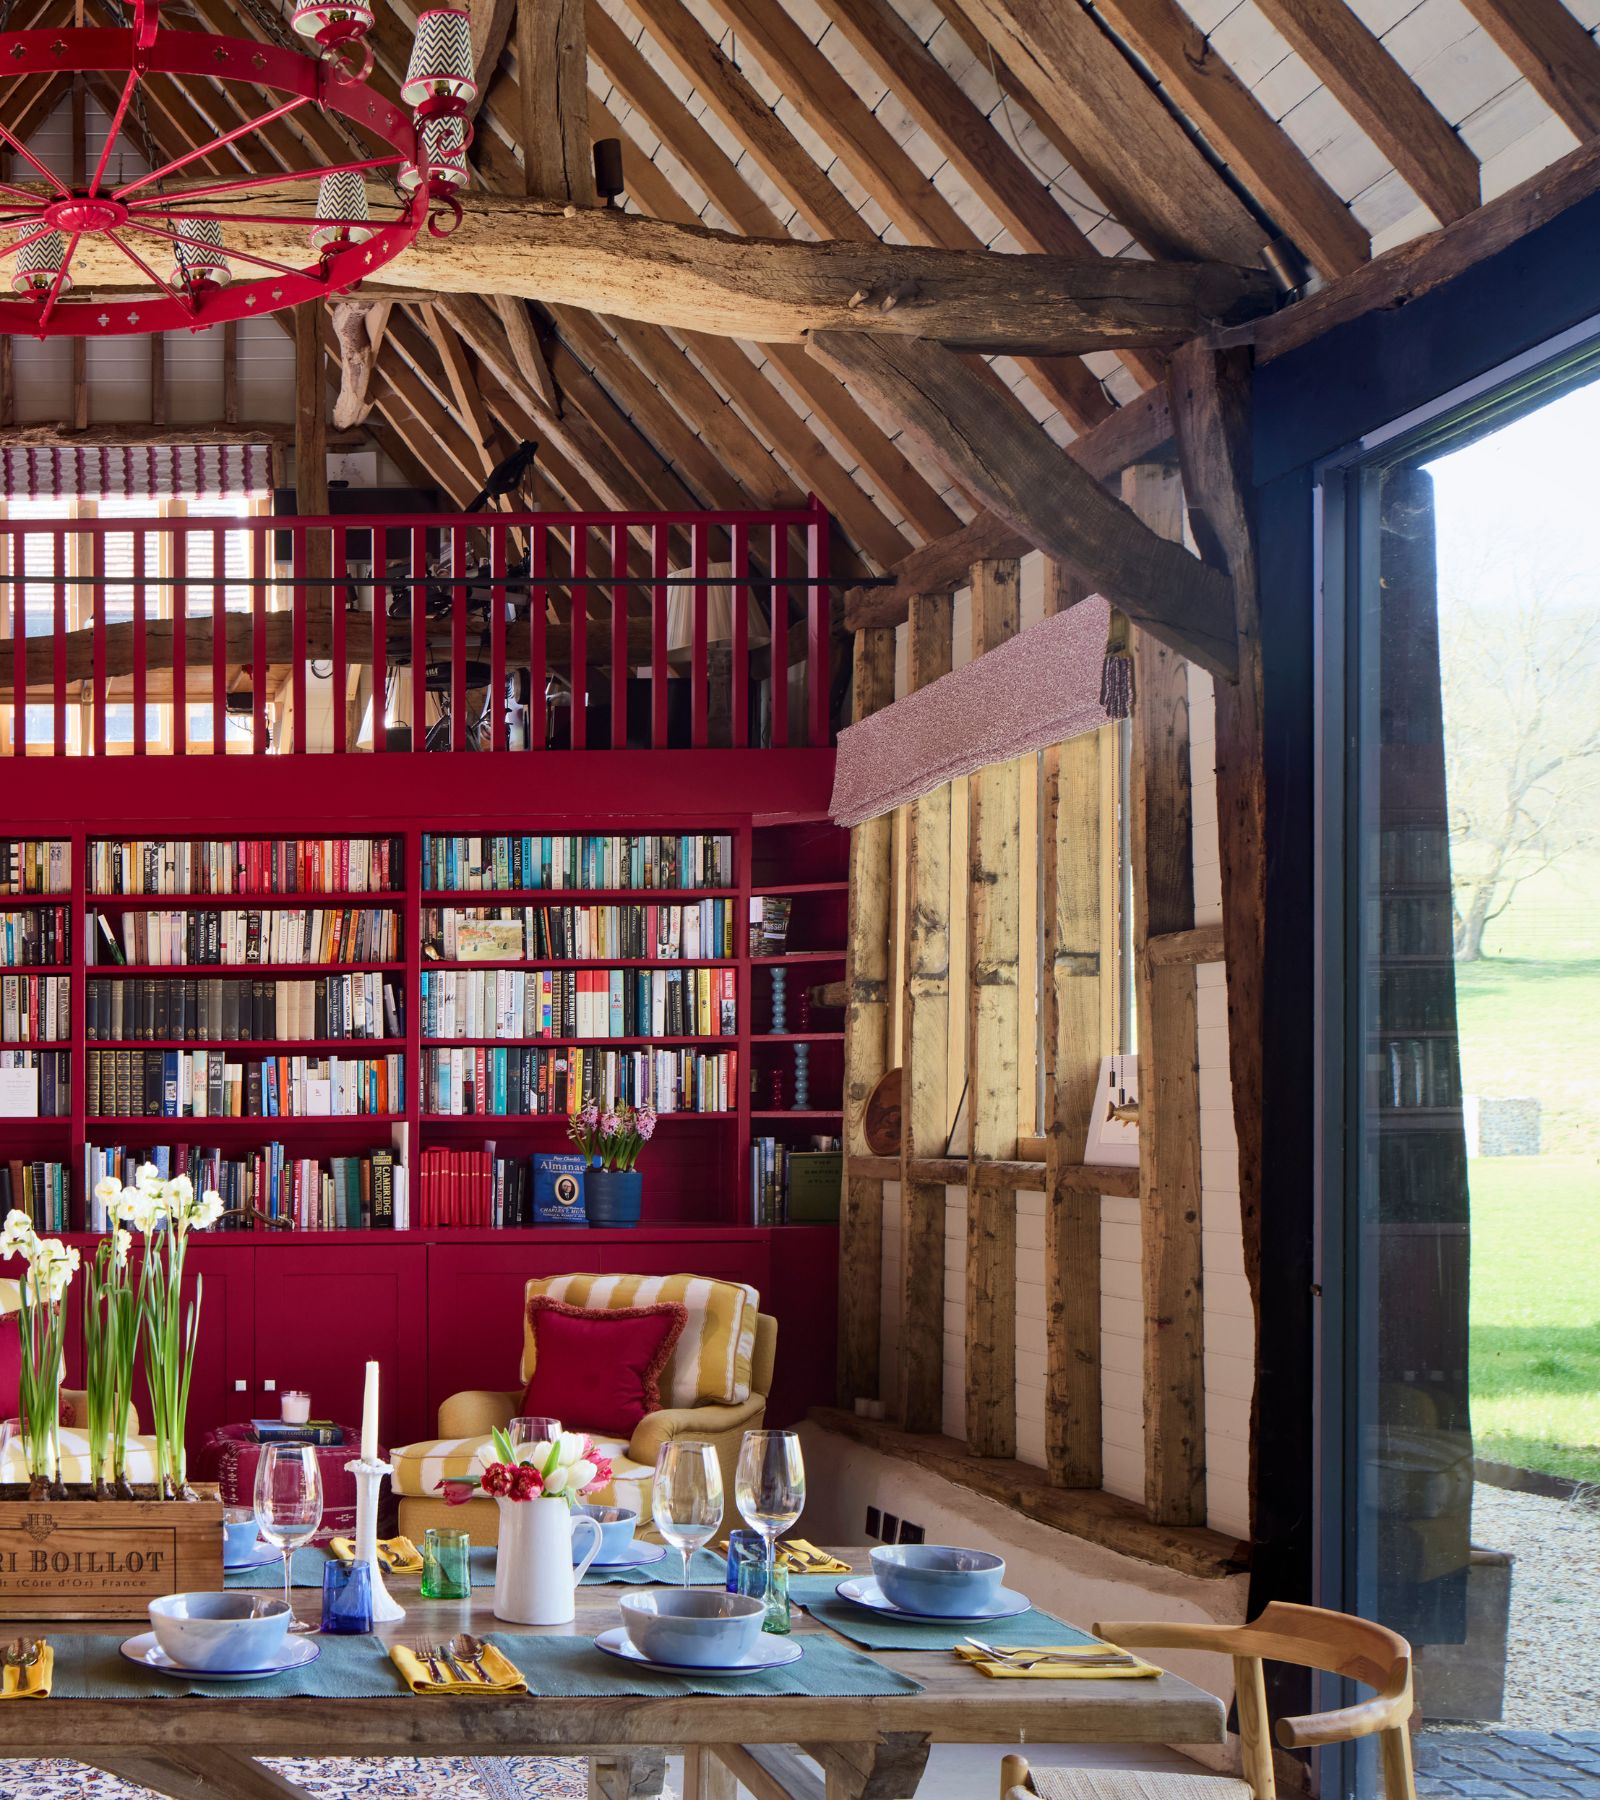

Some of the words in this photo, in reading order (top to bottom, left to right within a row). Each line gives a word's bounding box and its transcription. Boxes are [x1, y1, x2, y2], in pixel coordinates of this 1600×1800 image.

[354, 976, 363, 998] MUNICH
[527, 985, 535, 1011] TITAN
[61, 988, 70, 1015] TITAN
[538, 1065, 546, 1092] FORTUNES
[540, 1160, 587, 1172] Almanac
[375, 1166, 383, 1216] ENCYCLOPEDIA
[383, 1166, 391, 1215] CAMBRIDGE
[29, 1550, 164, 1574] BOILLOT
[102, 1580, 146, 1588] France
